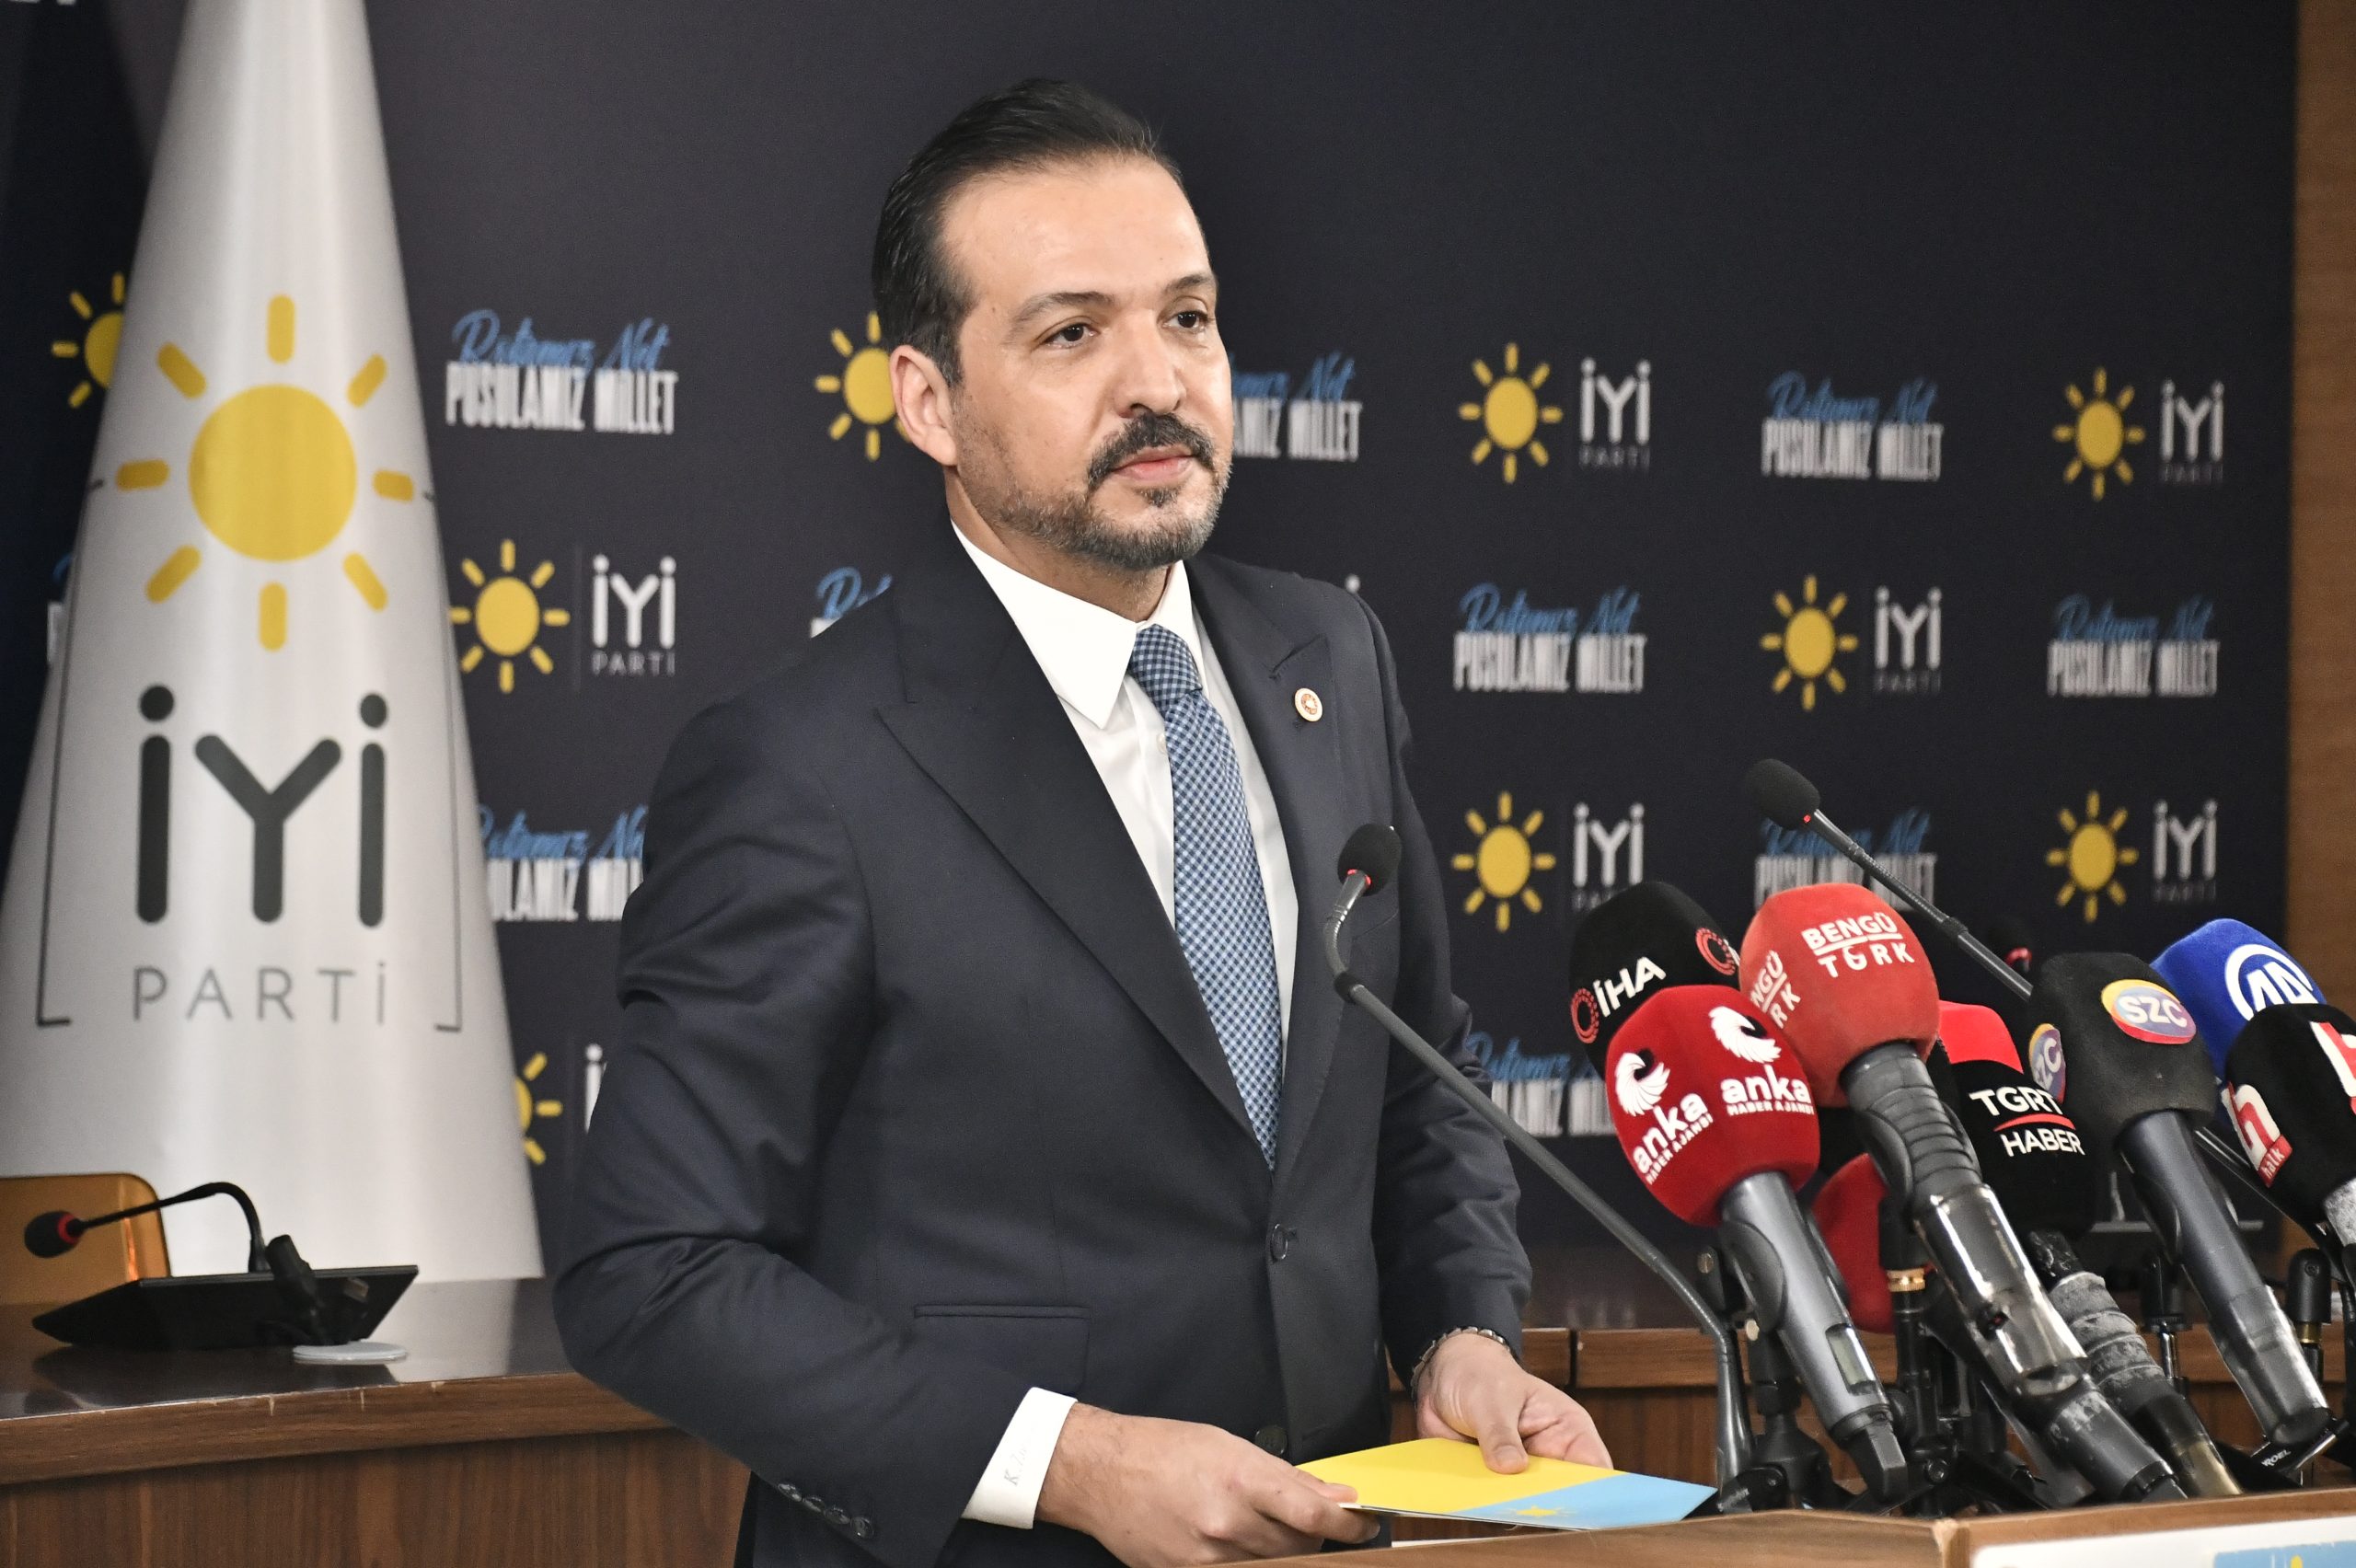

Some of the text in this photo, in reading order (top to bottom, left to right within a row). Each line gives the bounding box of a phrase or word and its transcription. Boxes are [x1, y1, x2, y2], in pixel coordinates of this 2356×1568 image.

[1801, 911, 1898, 951] BENGÜ
[1593, 956, 1666, 1017] İHA
[2119, 997, 2187, 1027] SZC
[1721, 1064, 1812, 1104] anka
[1969, 1086, 2062, 1116] TGRT
[1727, 1101, 1773, 1116] HABER
[1633, 1093, 1708, 1174] anka
[2000, 1128, 2085, 1158] HABER
